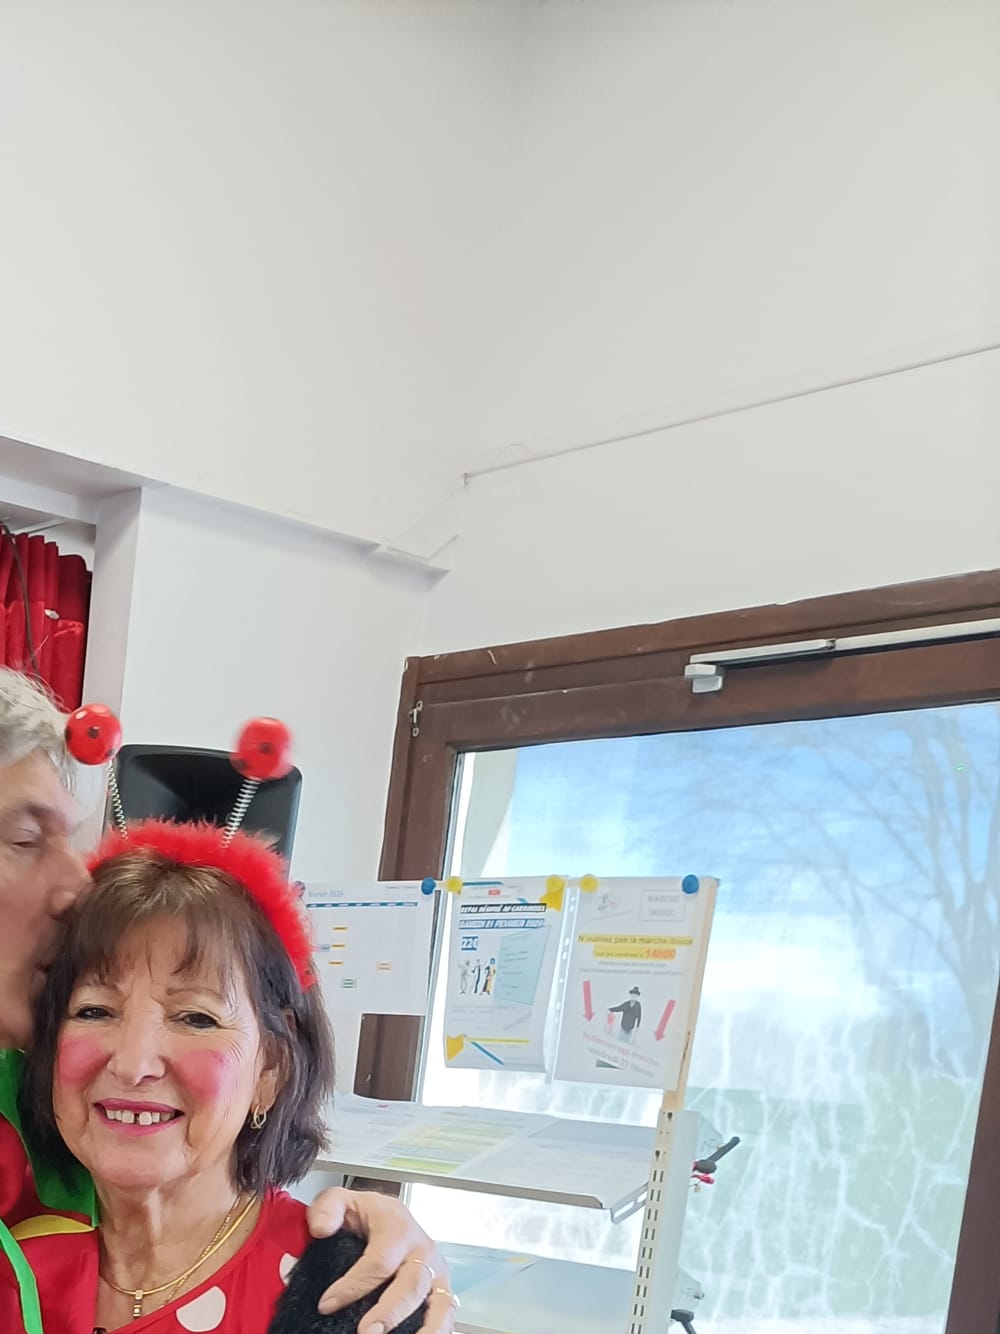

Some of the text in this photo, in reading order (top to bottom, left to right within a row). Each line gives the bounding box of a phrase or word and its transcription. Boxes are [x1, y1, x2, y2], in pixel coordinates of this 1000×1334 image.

[614, 936, 628, 945] pas
[630, 935, 637, 944] la
[638, 936, 668, 945] marche
